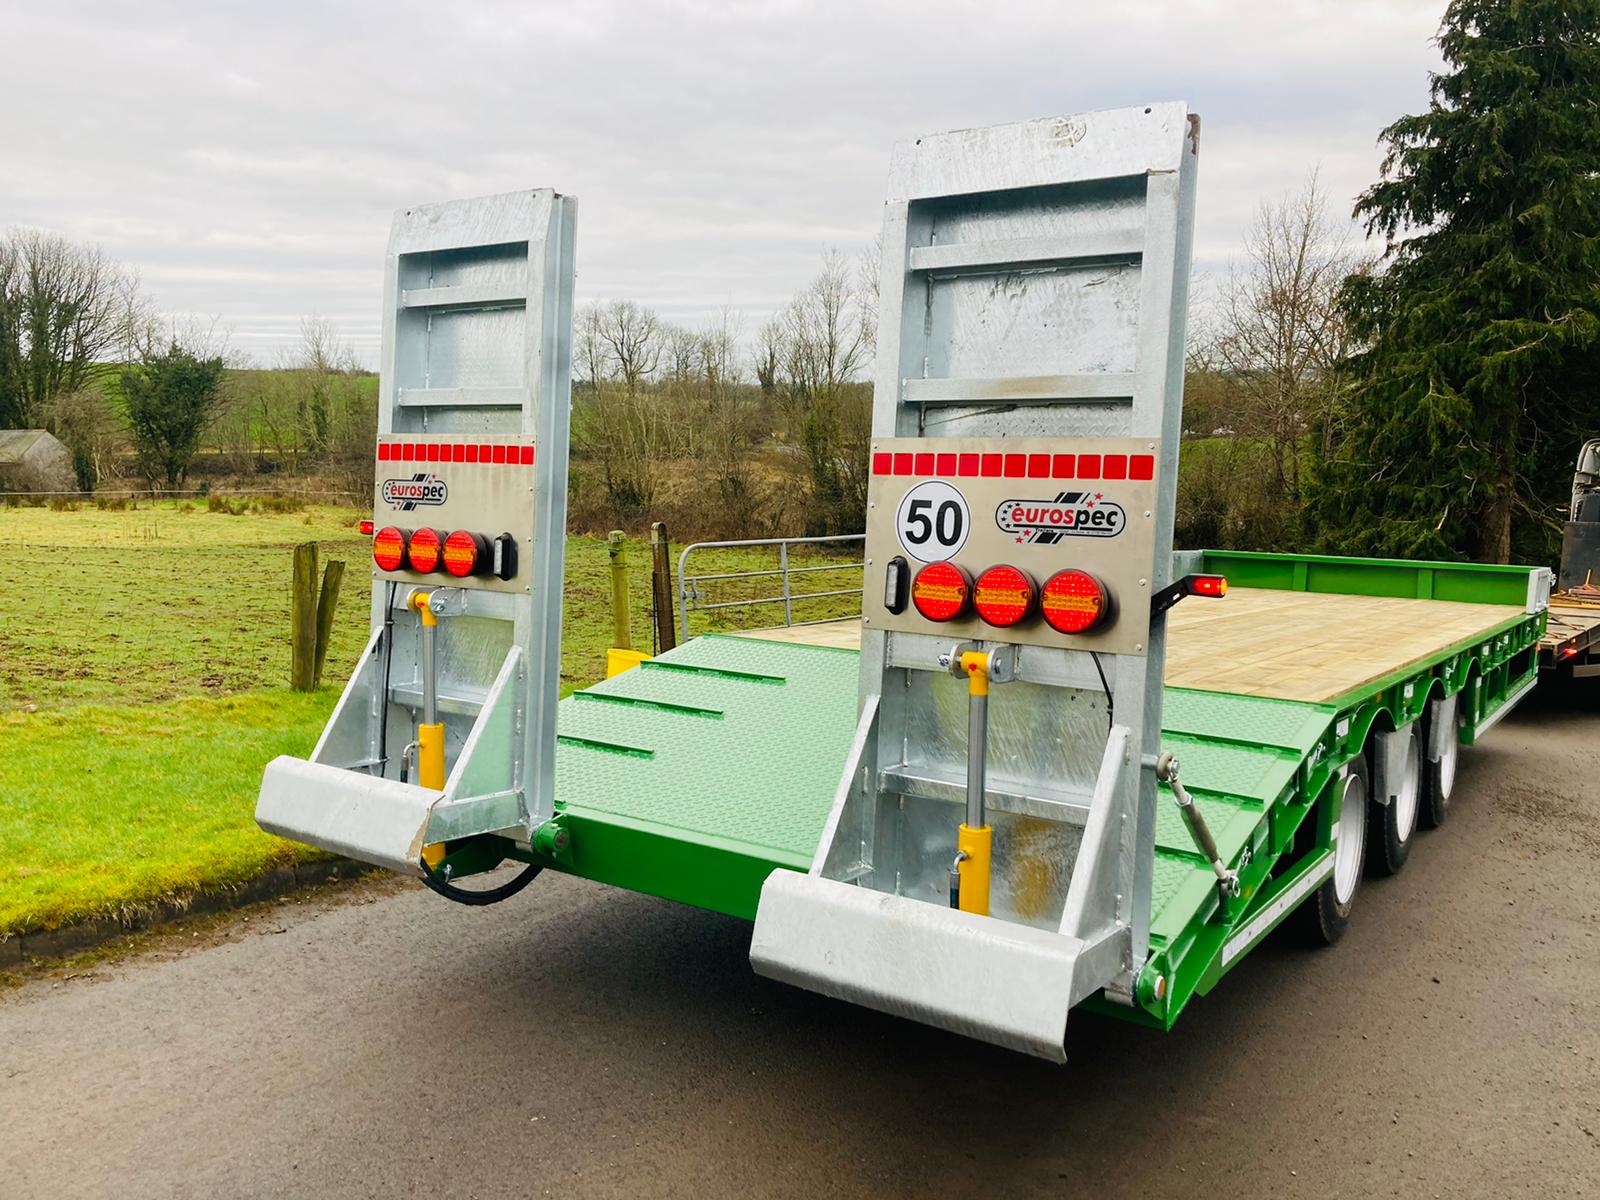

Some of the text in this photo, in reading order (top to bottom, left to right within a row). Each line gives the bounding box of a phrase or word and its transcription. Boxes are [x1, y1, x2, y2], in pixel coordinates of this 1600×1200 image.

[391, 484, 444, 500] eurospec
[905, 499, 963, 546] 50
[1011, 507, 1118, 529] eurospec
